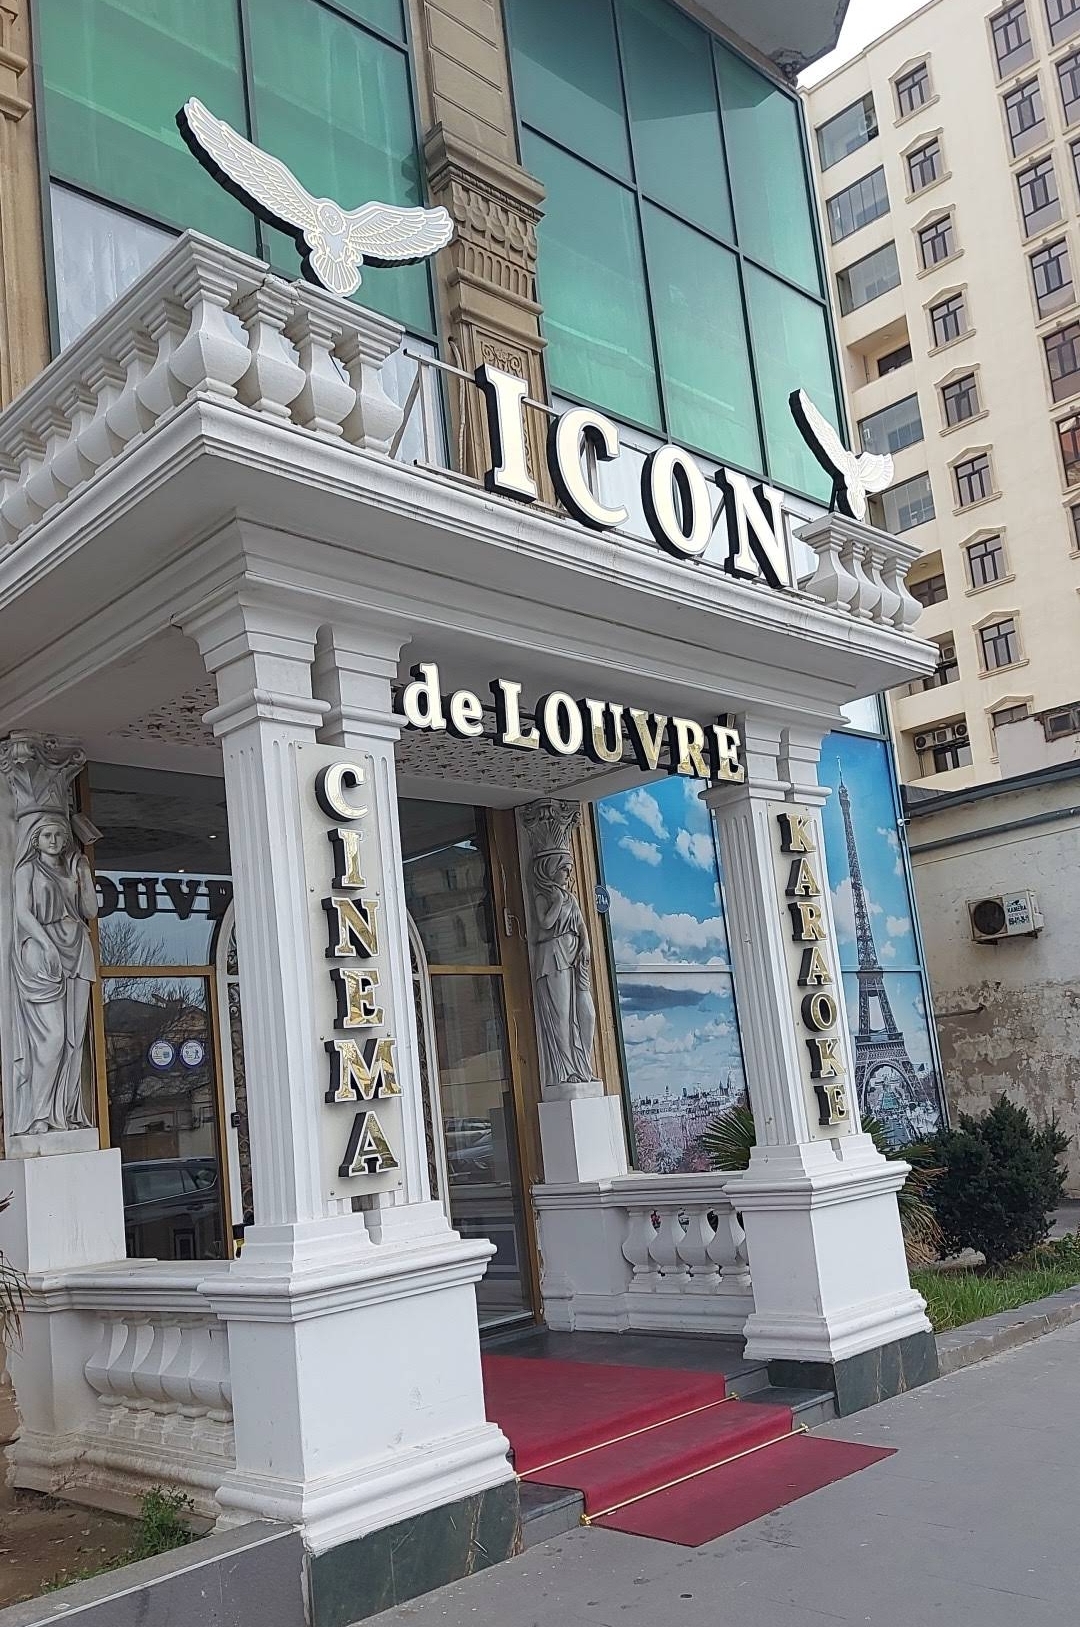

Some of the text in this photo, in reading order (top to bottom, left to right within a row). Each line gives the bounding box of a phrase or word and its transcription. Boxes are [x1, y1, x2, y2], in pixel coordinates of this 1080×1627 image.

[475, 363, 790, 588] ICON
[315, 761, 402, 1177] CINEMA
[777, 813, 850, 1125] KARAOKE
